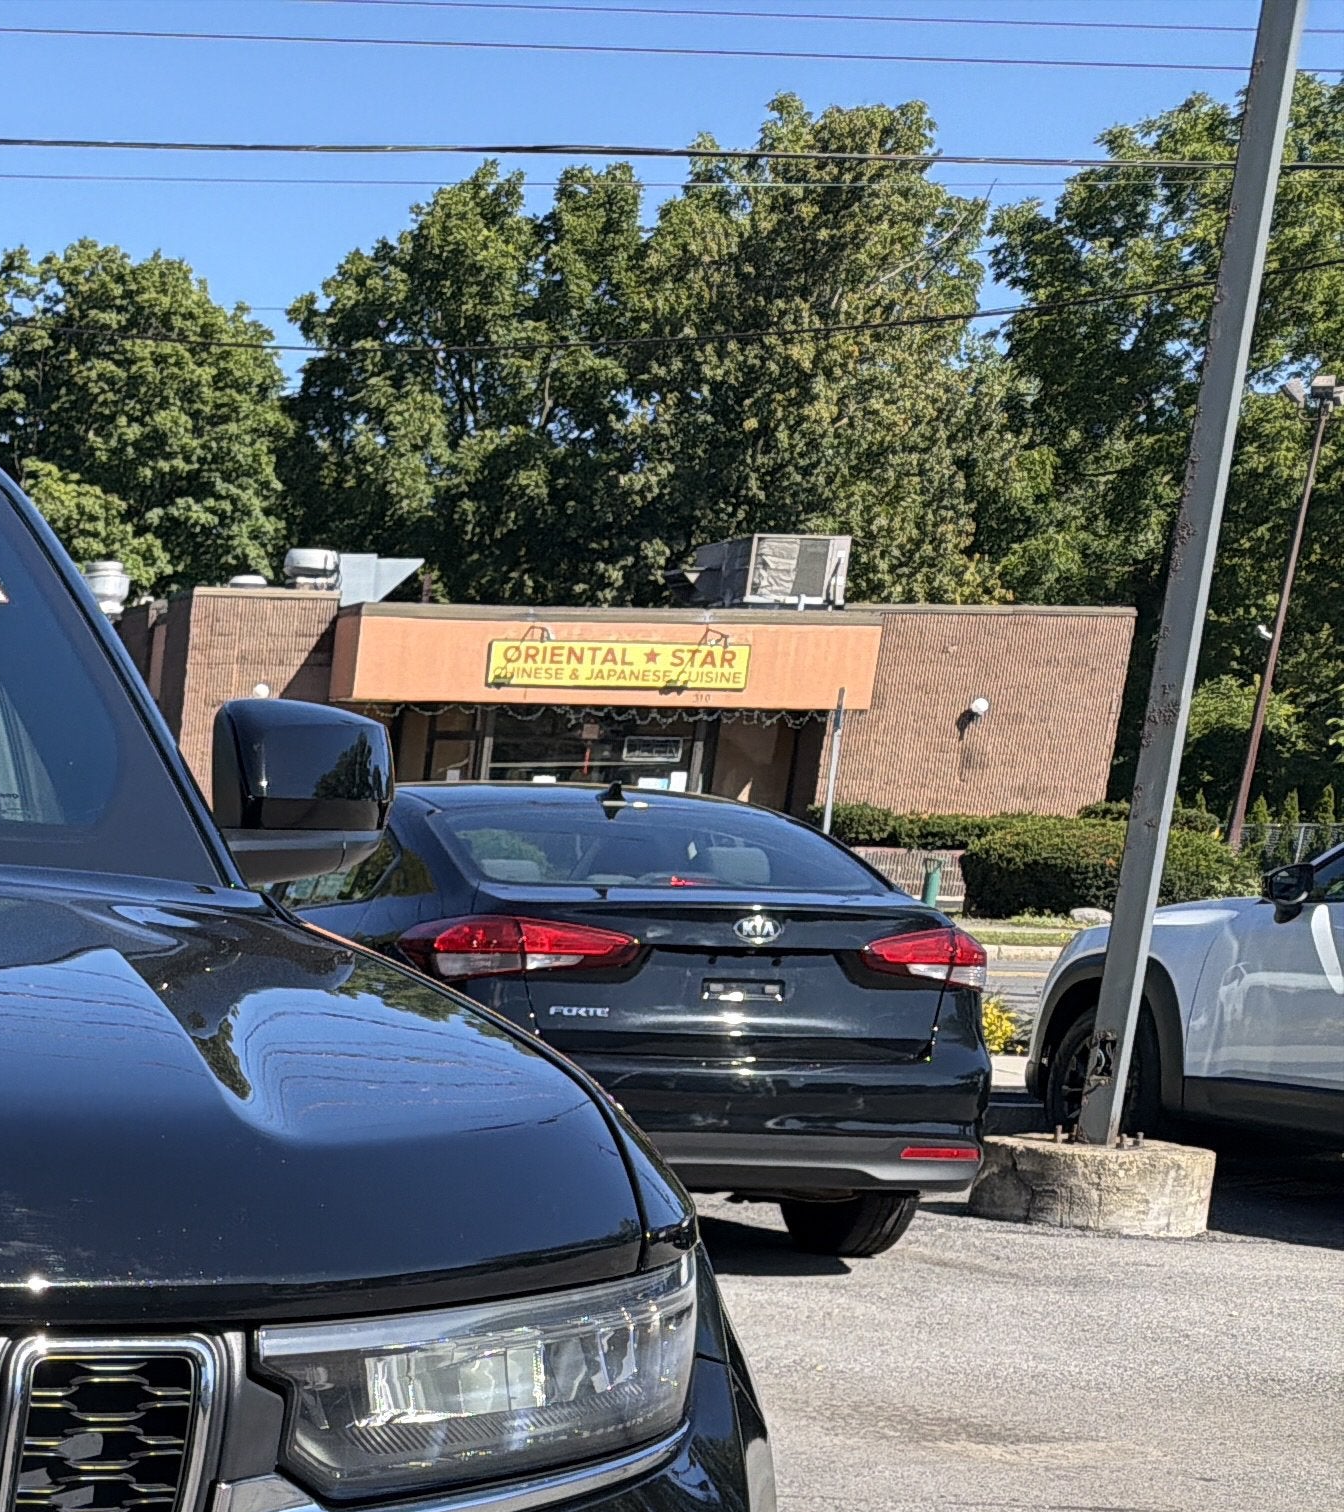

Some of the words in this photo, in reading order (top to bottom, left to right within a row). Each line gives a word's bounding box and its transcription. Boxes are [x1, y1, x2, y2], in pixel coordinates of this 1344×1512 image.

[503, 645, 634, 666] ORIENTAL
[669, 648, 737, 668] STAR
[568, 667, 581, 681] &
[585, 667, 672, 683] JAPANESE
[548, 1005, 610, 1018] FORTE
